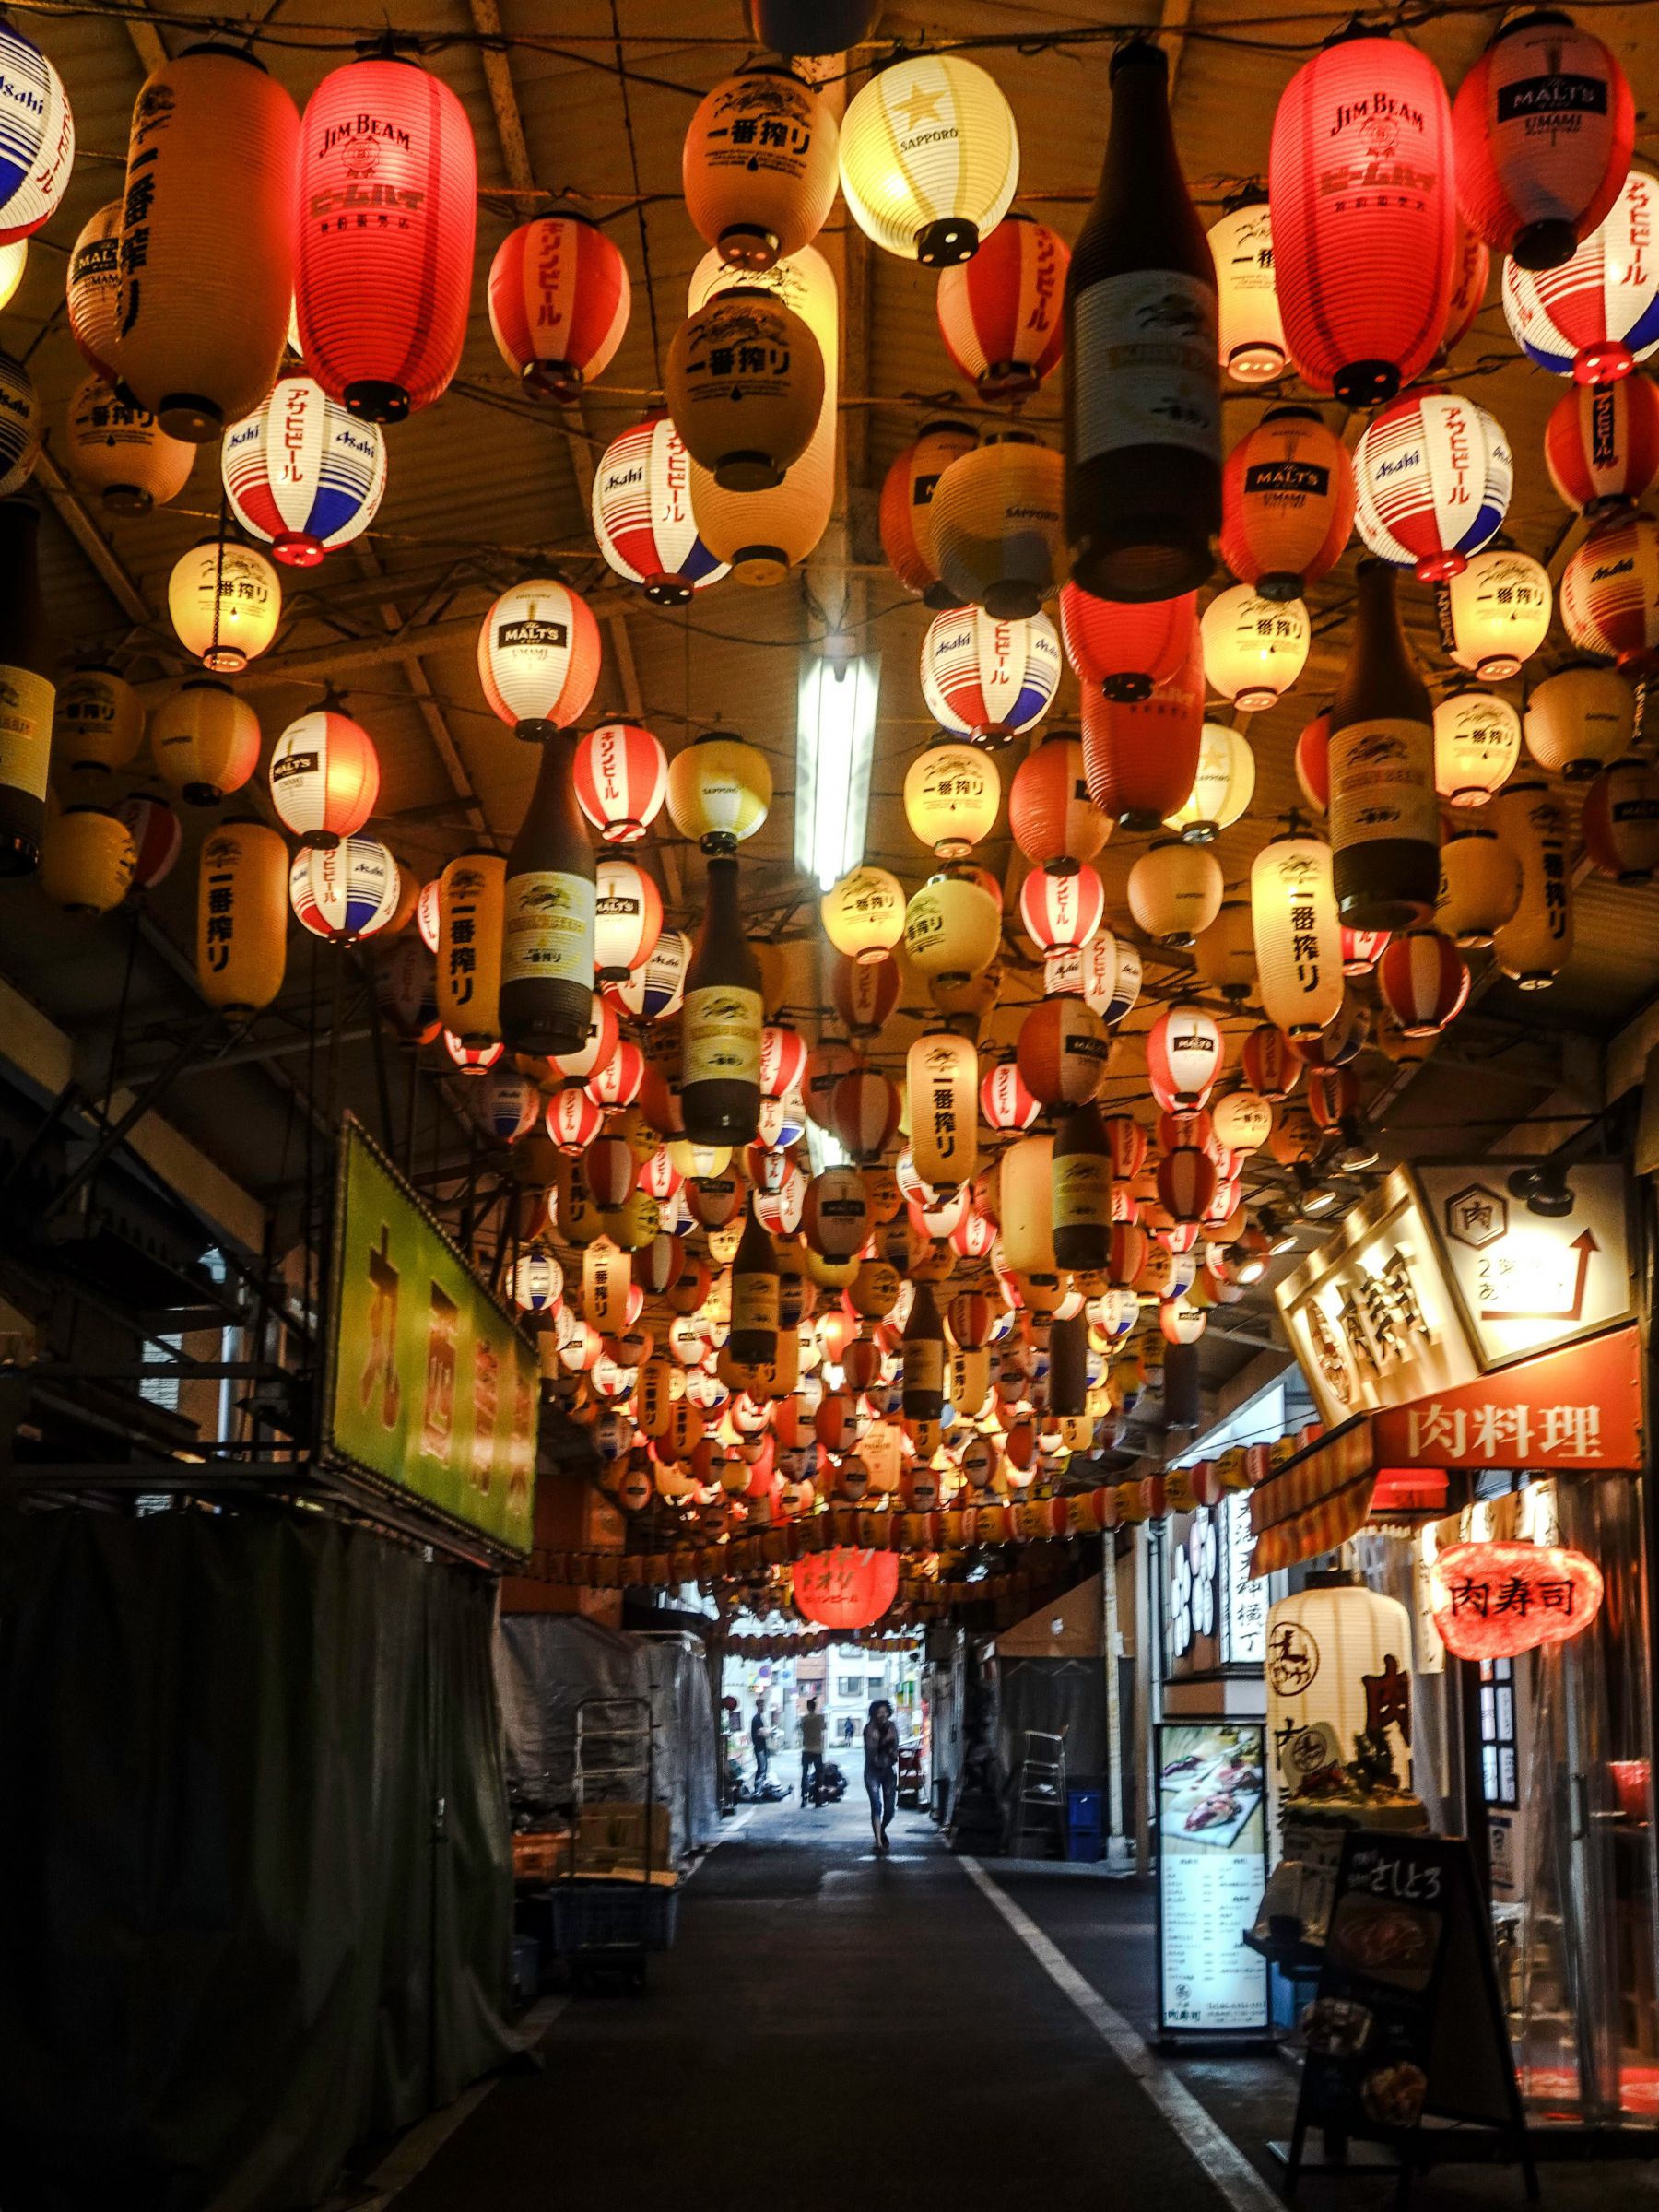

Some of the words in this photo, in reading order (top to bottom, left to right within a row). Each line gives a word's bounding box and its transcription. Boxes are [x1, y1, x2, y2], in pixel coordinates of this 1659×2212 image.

[1330, 100, 1368, 137] JIM
[1371, 92, 1425, 133] BEAM
[318, 123, 356, 158] JIM
[356, 114, 411, 151] BEAM
[708, 118, 810, 155] 一番搾り
[900, 127, 959, 153] SAPPORO
[686, 346, 791, 377] 一番搾り
[75, 404, 156, 429] 一番搾り
[282, 388, 311, 483] アサヒビール
[335, 429, 377, 460] Asahi
[1374, 449, 1421, 481] Asahi
[1441, 406, 1473, 506] アサヒビール
[605, 466, 644, 494] Asahi
[1255, 470, 1320, 487] MALT'S
[197, 579, 270, 605] 一番搾り
[1477, 587, 1546, 607] 一番搾り
[504, 626, 560, 642] MALT'S
[1236, 618, 1303, 640] 一番搾り
[1453, 729, 1514, 747] 一番搾り
[601, 731, 619, 800] キリンビール
[924, 780, 984, 796] 一番搾り
[842, 896, 895, 912] 一番搾り
[208, 873, 235, 973] 一番搾り
[451, 905, 477, 1006] 一番搾り
[1289, 892, 1321, 993] 一番搾り
[933, 1077, 957, 1159] 一番搾り
[594, 1263, 609, 1318] 一番搾り
[1406, 1402, 1605, 1459] 肉料理
[1449, 1576, 1575, 1617] 肉寿司
